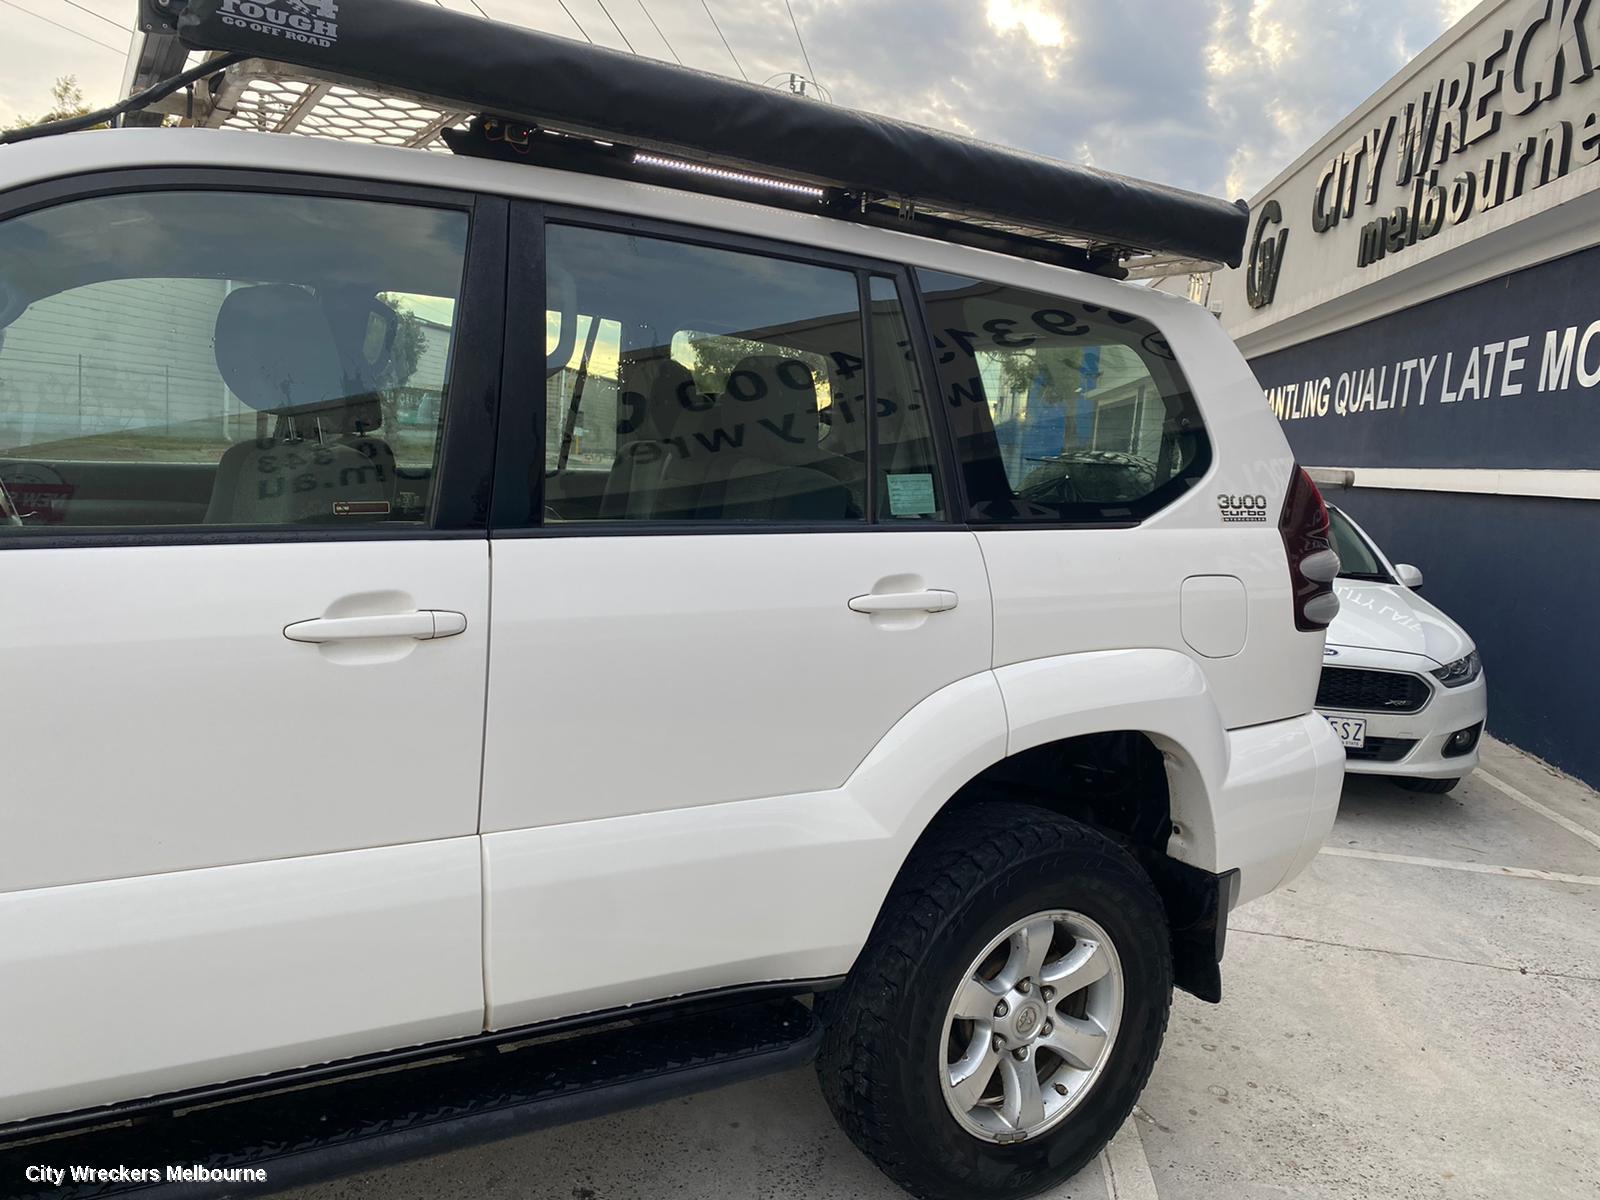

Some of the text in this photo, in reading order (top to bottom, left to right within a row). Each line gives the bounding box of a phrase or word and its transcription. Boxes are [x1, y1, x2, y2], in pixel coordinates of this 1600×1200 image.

[220, 0, 338, 37] TOUGH
[222, 16, 331, 47] GO OFF ROAD
[1311, 116, 1397, 234] CITY
[1357, 113, 1600, 267] melbourne
[1264, 376, 1331, 420] ANTLING
[1334, 355, 1438, 417] QUALITY
[1440, 336, 1530, 404] LATE
[1217, 494, 1267, 509] 3000
